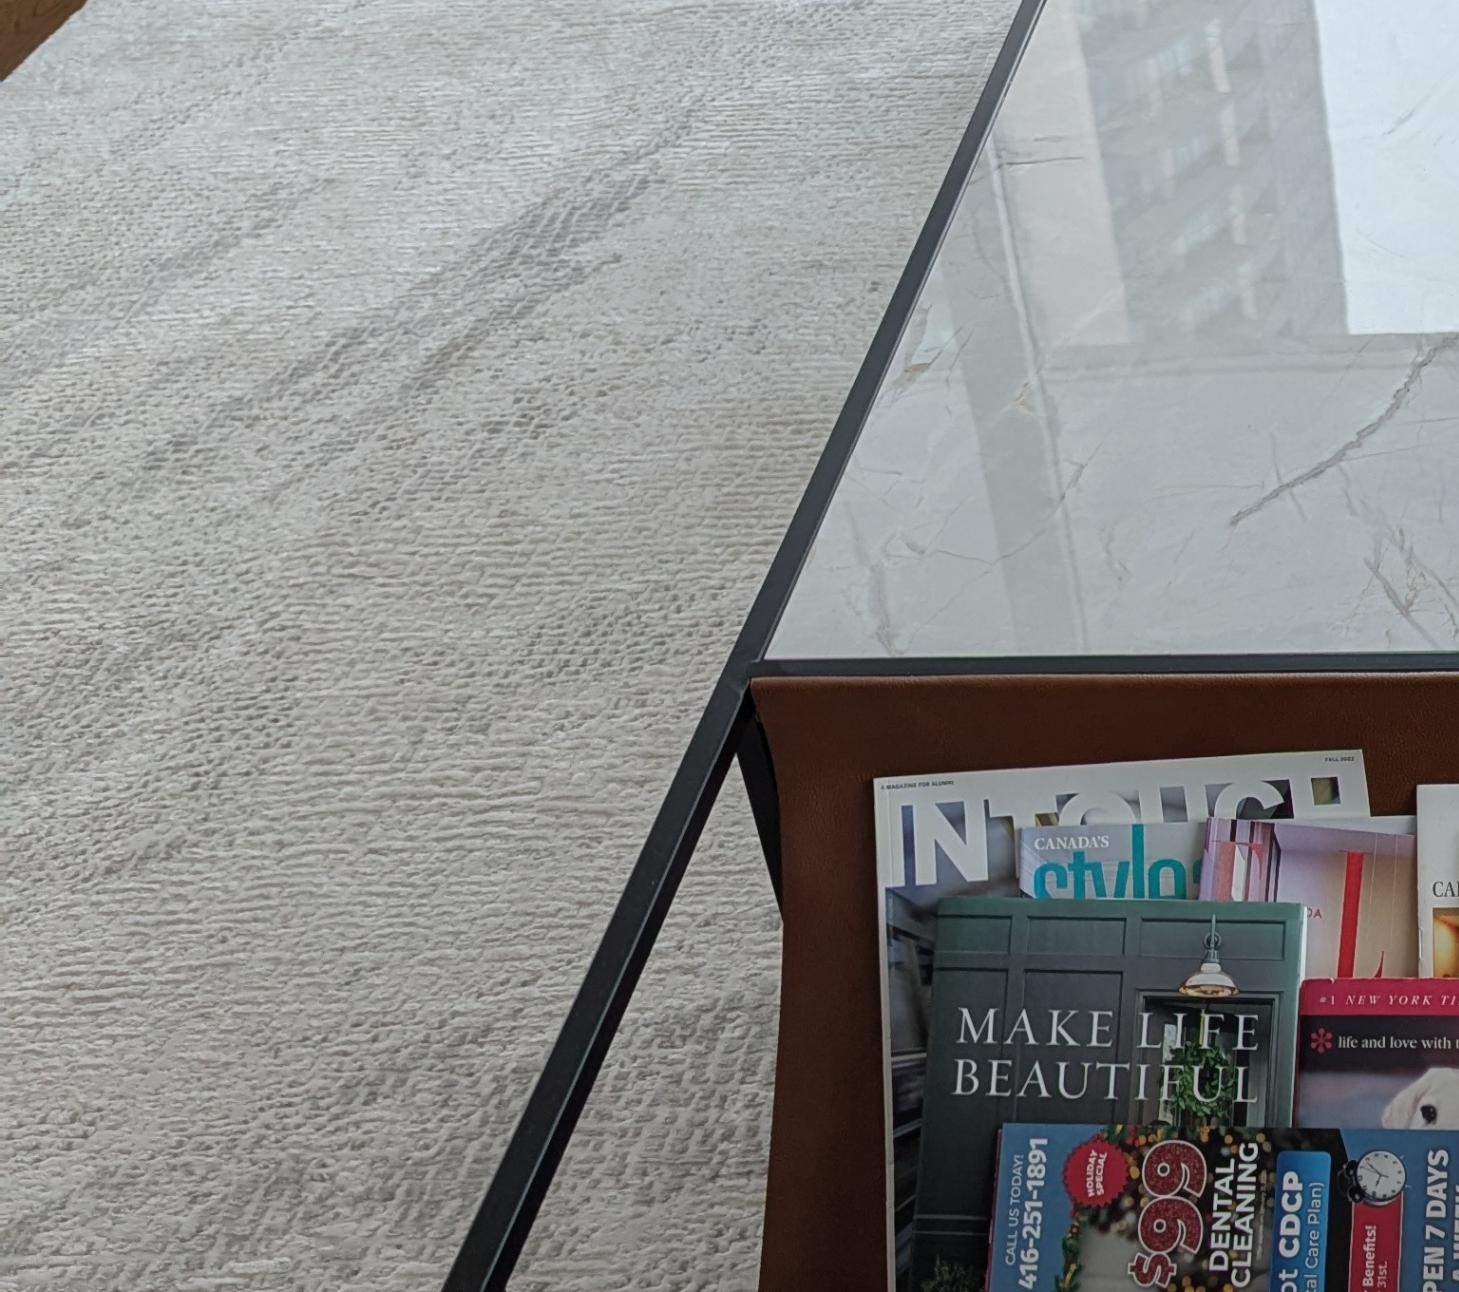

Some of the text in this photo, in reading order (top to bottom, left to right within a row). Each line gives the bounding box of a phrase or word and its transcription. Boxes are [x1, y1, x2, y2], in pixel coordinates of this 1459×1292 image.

[1034, 835, 1110, 850] CANADA'S
[1319, 995, 1335, 1006] #1
[1345, 995, 1381, 1006] NEW
[1388, 995, 1432, 1006] YORK
[956, 1007, 1259, 1051] MAKE LIFE
[1338, 1036, 1358, 1049] life
[1361, 1036, 1386, 1049] and
[1389, 1036, 1418, 1049] love
[1421, 1037, 1452, 1050] with
[951, 1059, 1258, 1104] BEAUTIFUL
[1087, 1149, 1098, 1198] HOLIDAY
[1096, 1151, 1108, 1195] SPECIAL
[1426, 1149, 1449, 1218] DAYS
[1005, 1154, 1025, 1266] CALL US TODAY!
[1019, 1138, 1048, 1290] 416-251-1891
[1127, 1139, 1208, 1289] $99
[1209, 1158, 1235, 1272] DENTAL
[1230, 1142, 1259, 1288] CLEANING
[1279, 1171, 1303, 1258] CDCP
[1308, 1182, 1325, 1225] Plan)
[1305, 1230, 1320, 1265] Care
[1425, 1224, 1446, 1240] 7
[1362, 1225, 1377, 1288] Benefits!
[1377, 1261, 1387, 1288] 31st.
